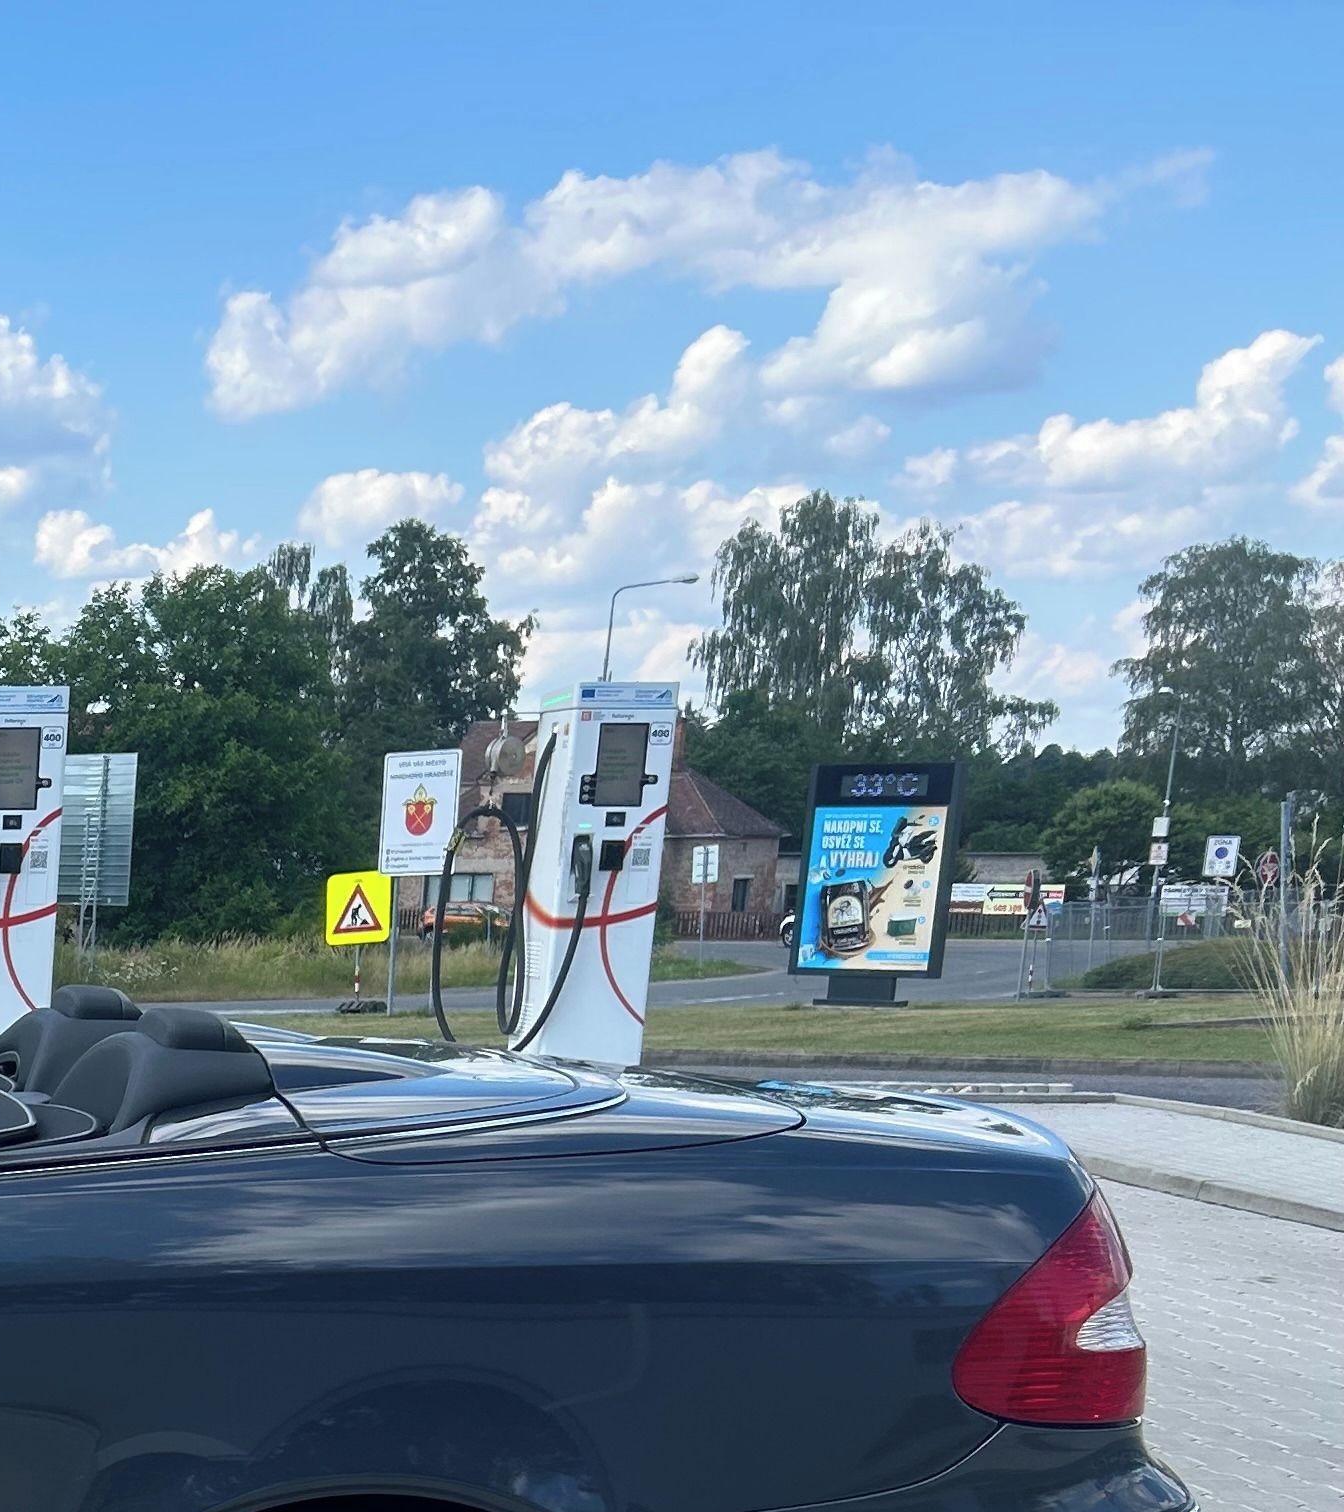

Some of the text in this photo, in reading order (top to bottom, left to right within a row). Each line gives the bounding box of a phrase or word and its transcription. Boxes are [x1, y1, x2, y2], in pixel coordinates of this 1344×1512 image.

[43, 733, 61, 742] 400
[823, 820, 867, 834] NAKOPNI
[853, 836, 865, 849] SE
[829, 851, 879, 869] VYHRAJ
